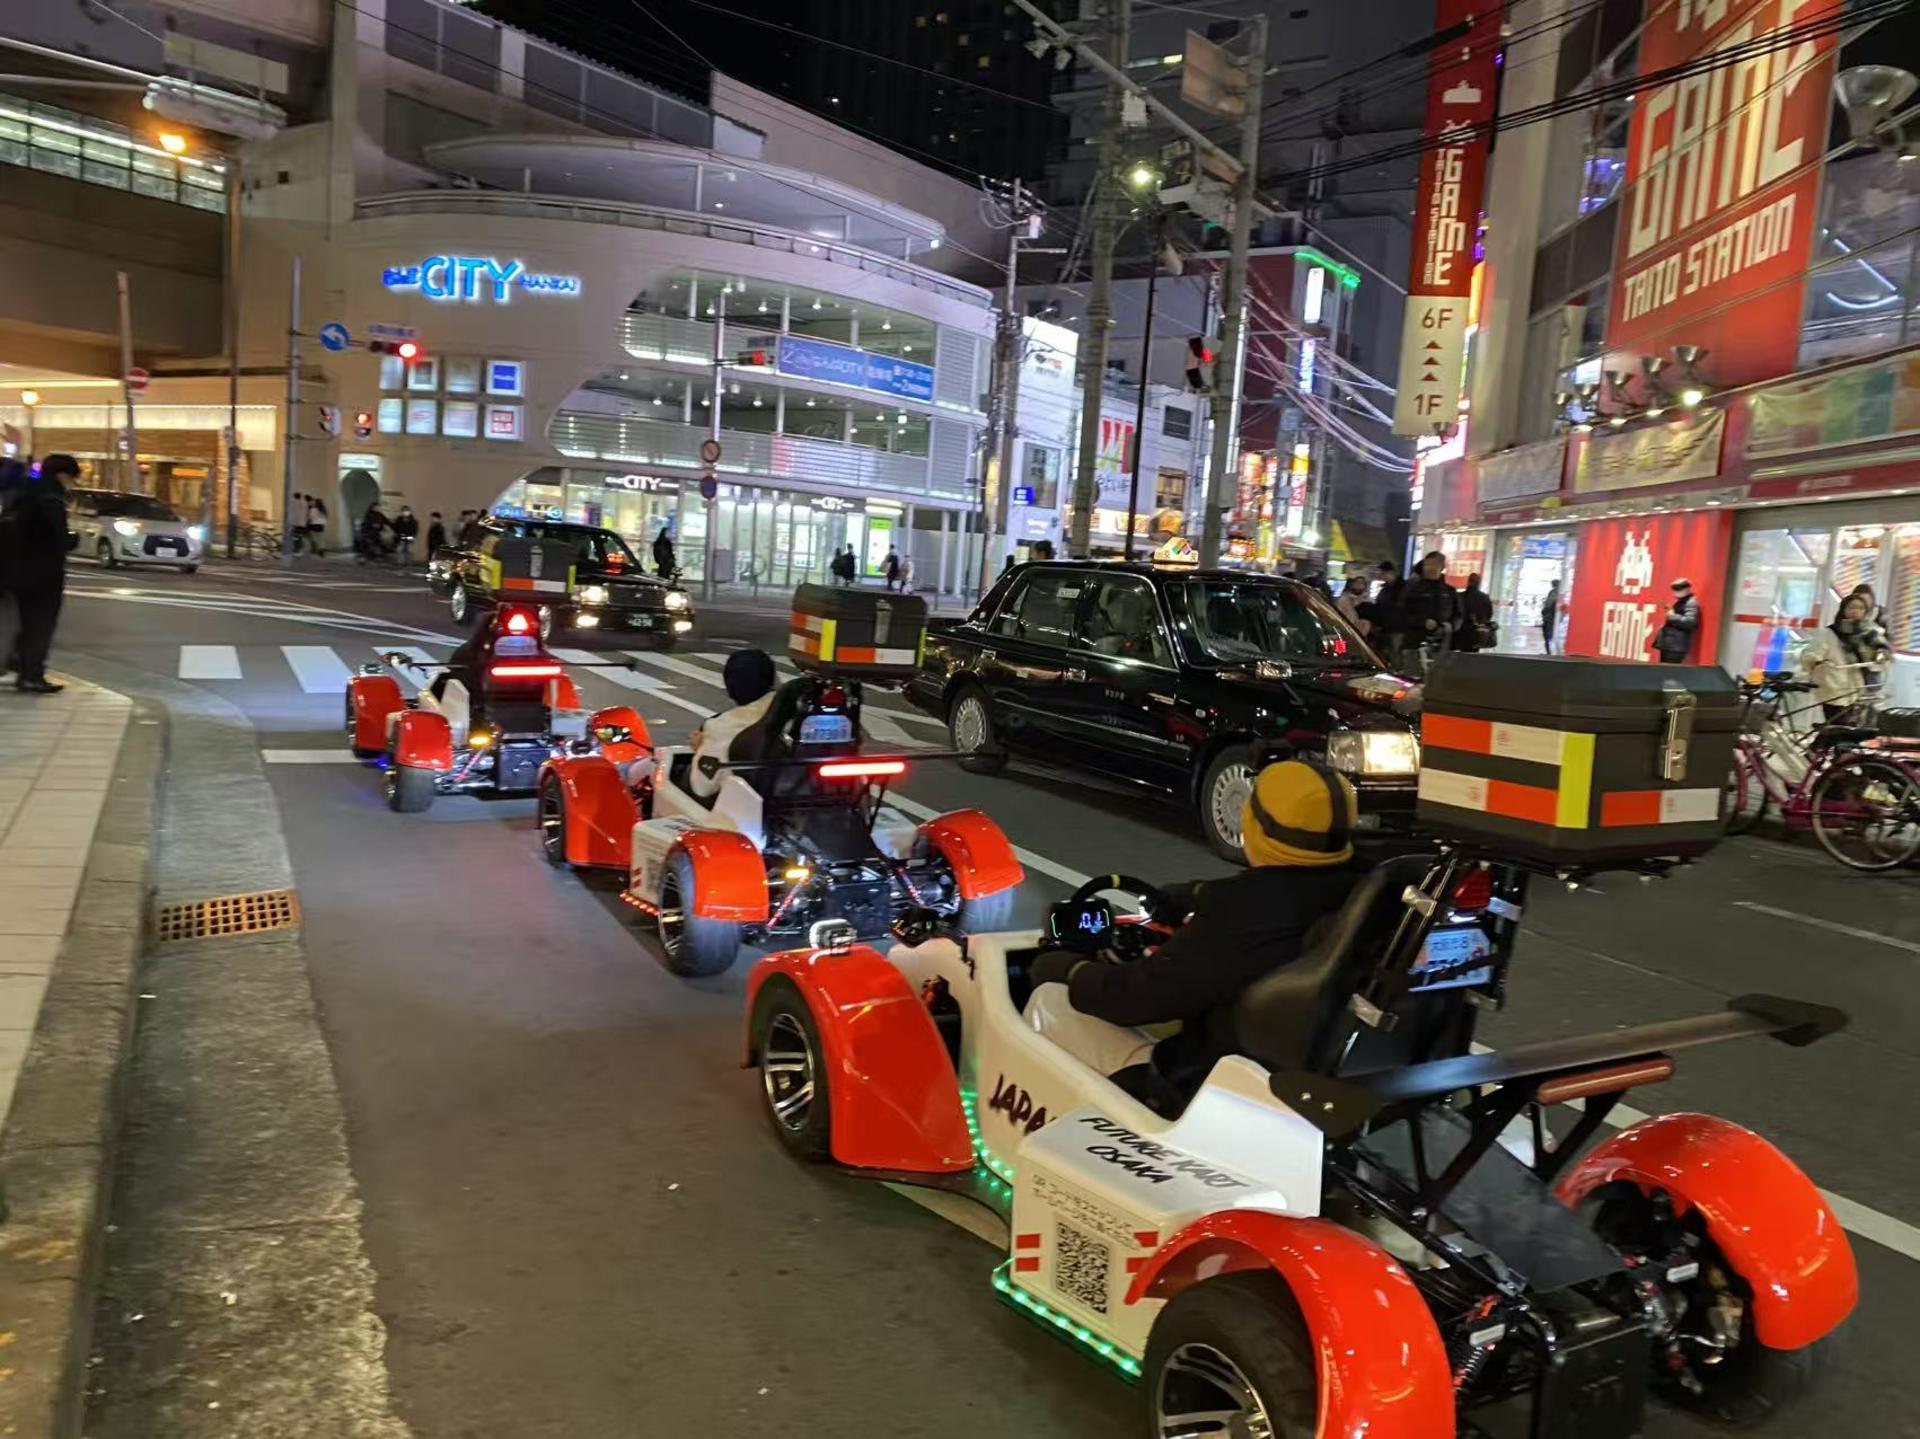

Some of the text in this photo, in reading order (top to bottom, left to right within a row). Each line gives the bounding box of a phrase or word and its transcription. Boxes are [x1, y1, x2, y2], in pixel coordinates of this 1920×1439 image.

[1627, 0, 1816, 259] GAME
[1433, 149, 1467, 285] GAME
[420, 256, 520, 302] CITY
[1622, 192, 1797, 323] TAITO STATION
[1422, 307, 1453, 329] 6F
[1413, 394, 1443, 415] 1F
[623, 475, 661, 490] CITY
[1600, 601, 1657, 662] GAME
[988, 1074, 1057, 1136] JAPA
[1078, 1116, 1250, 1189] FUTURE KART
[1086, 1145, 1174, 1184] OSAKA
